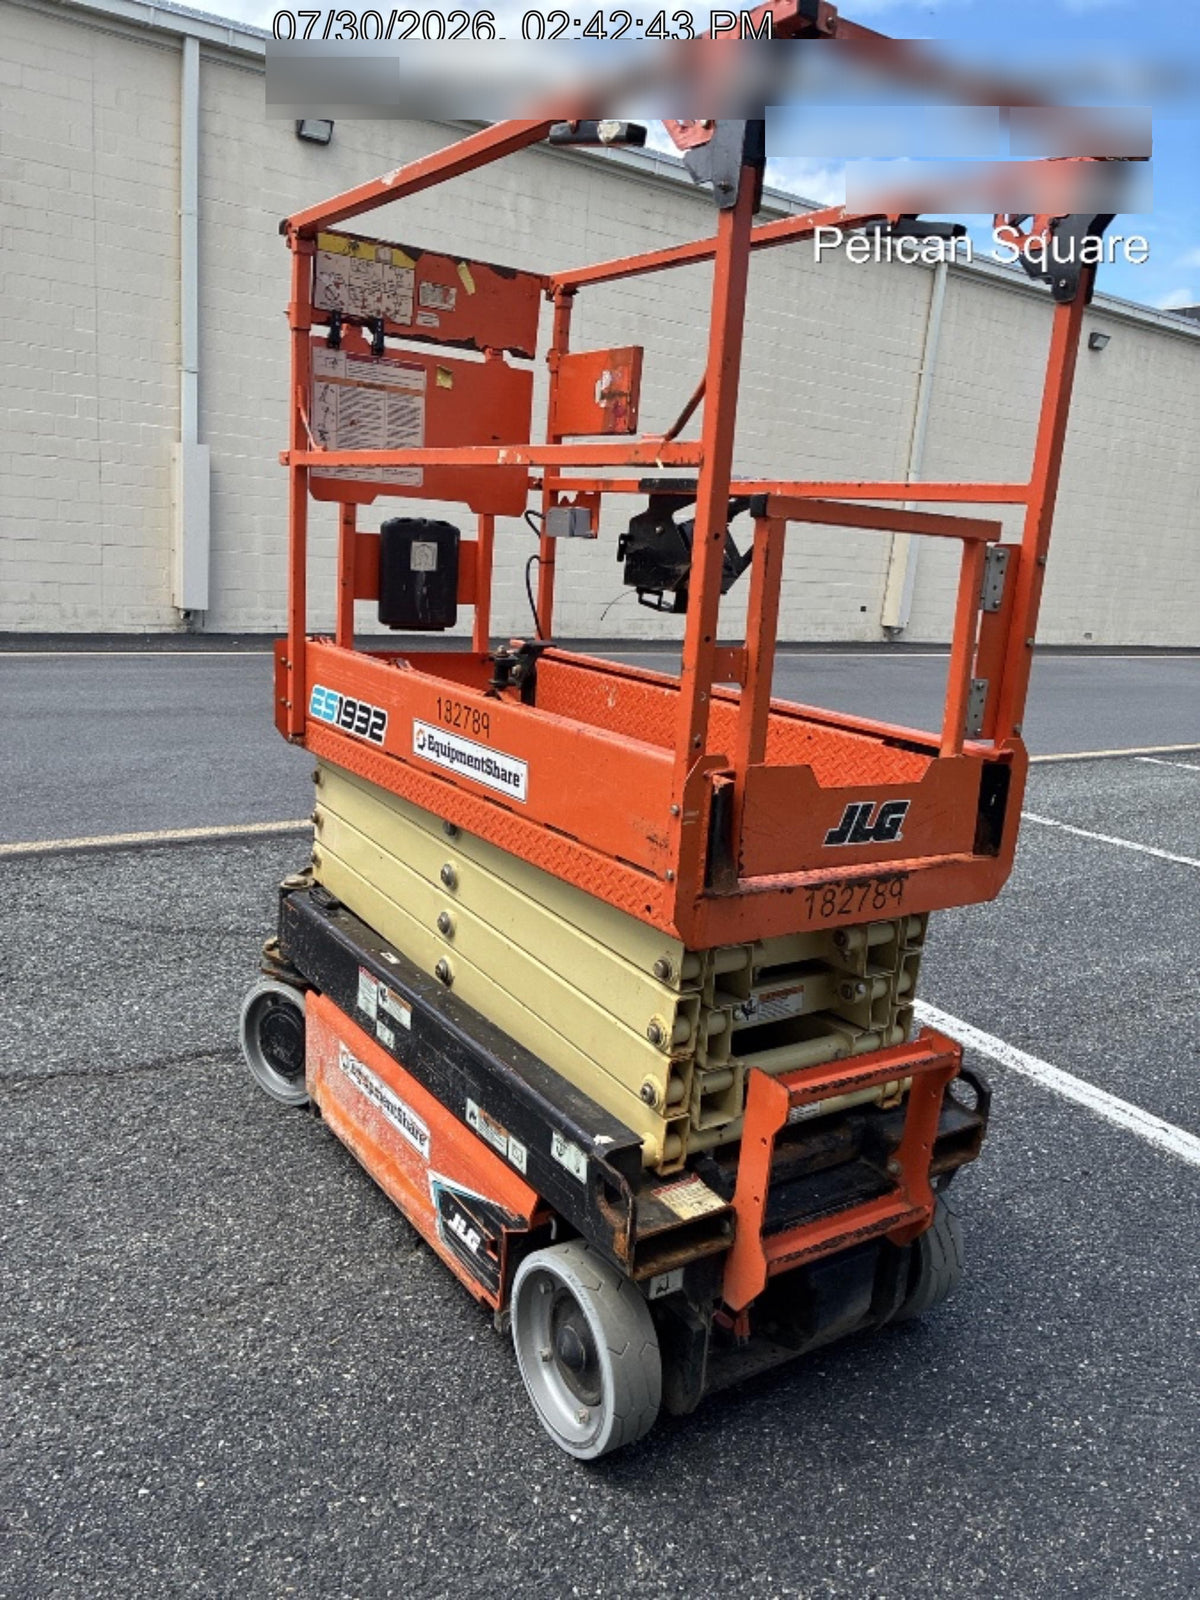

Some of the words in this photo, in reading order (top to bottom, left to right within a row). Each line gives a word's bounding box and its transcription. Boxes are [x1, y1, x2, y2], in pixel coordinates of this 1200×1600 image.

[310, 685, 388, 744] ES1932
[427, 734, 521, 788] EquipmentShare
[823, 800, 911, 847] JLG
[805, 878, 904, 920] 182789
